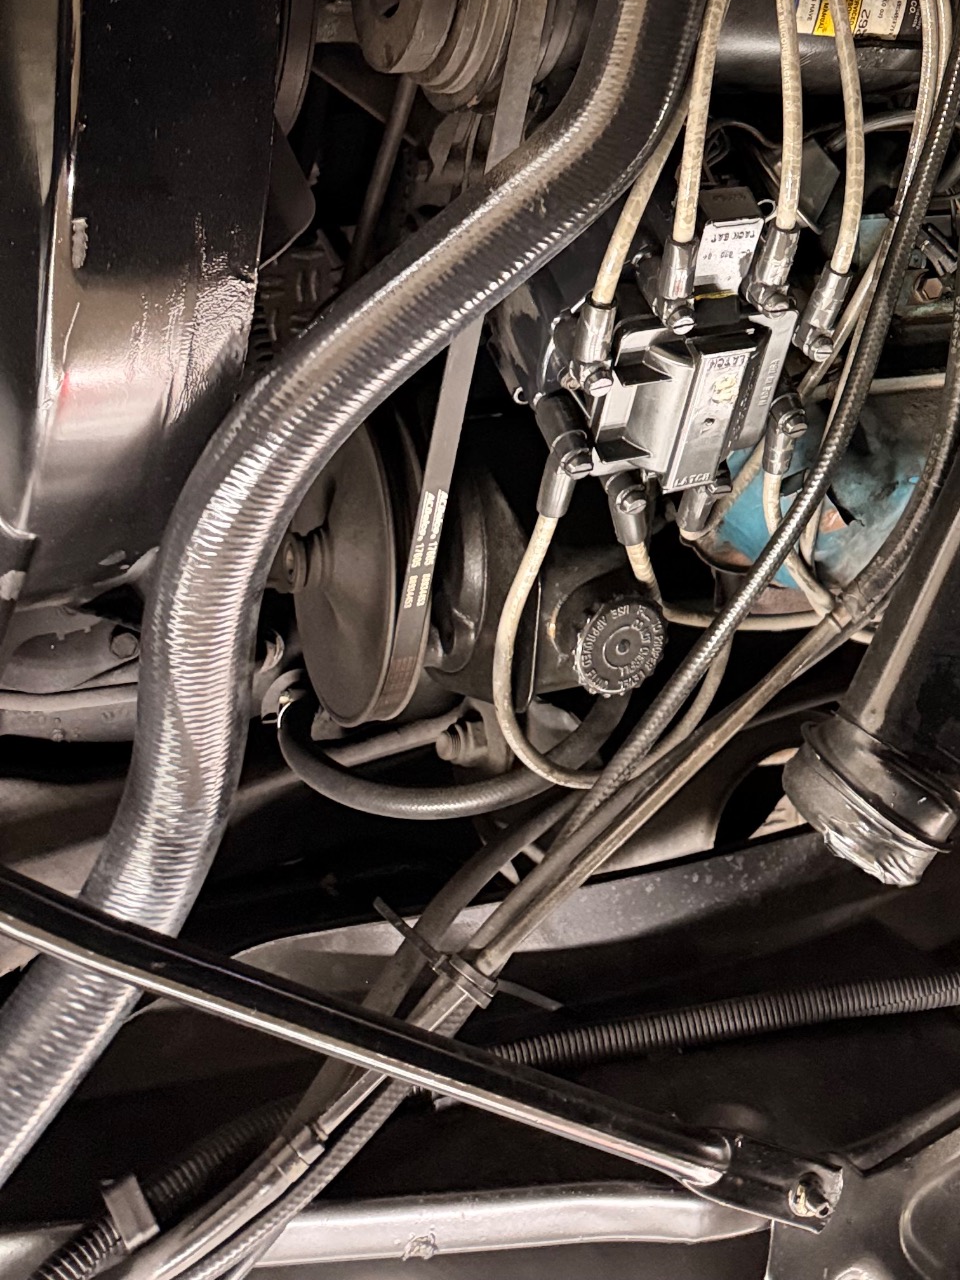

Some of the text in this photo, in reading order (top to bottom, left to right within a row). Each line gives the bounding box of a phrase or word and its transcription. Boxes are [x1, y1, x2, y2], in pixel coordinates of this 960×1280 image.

[807, 4, 816, 22] HAVE
[817, 3, 828, 30] MANUAL
[782, 60, 792, 95] JACKET
[412, 543, 425, 568] 17605
[425, 540, 438, 566] 17605
[611, 605, 629, 619] USE
[581, 616, 607, 667] APPROVED
